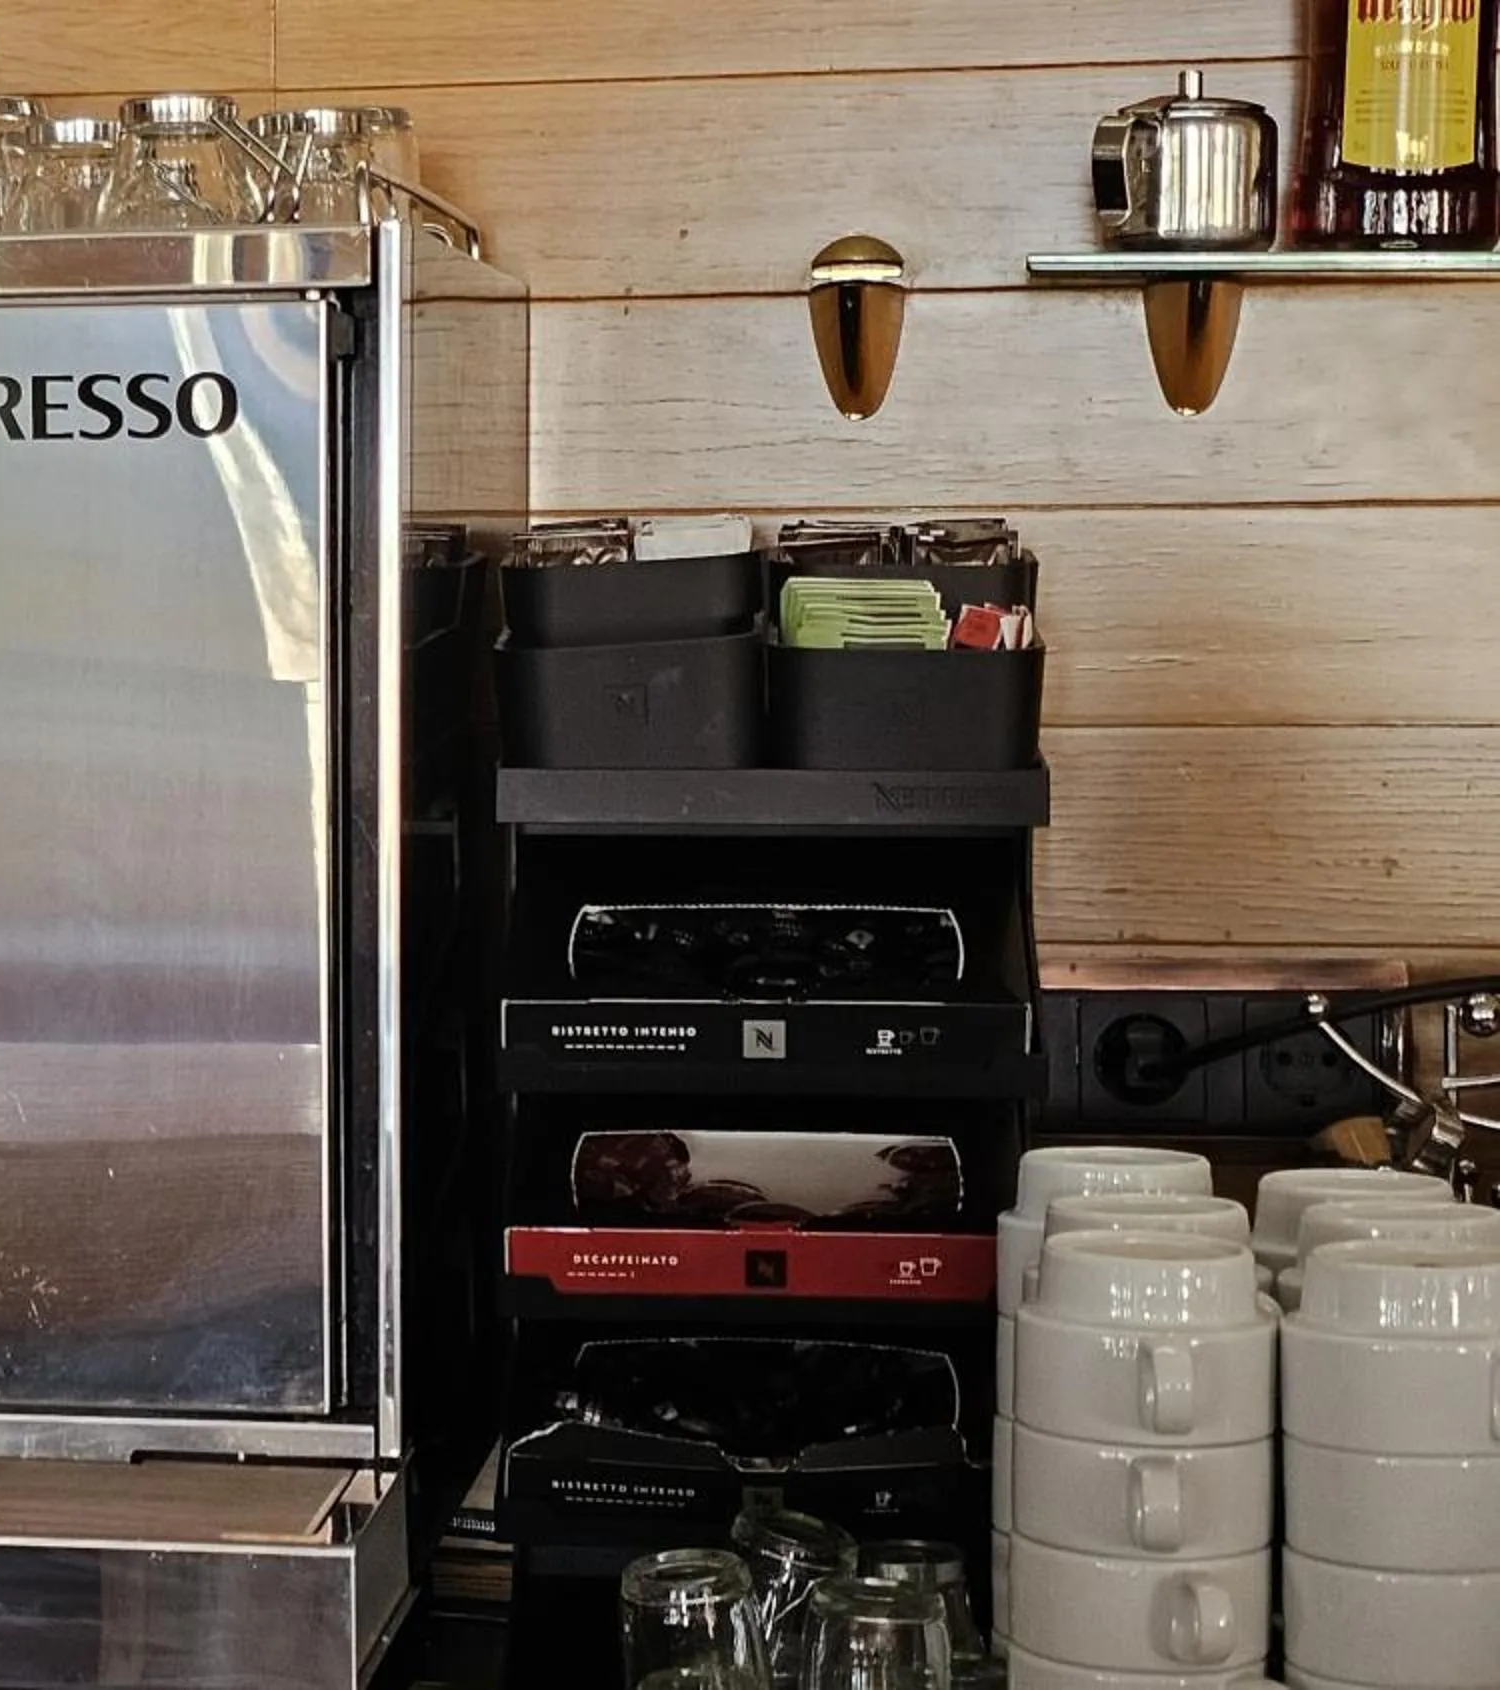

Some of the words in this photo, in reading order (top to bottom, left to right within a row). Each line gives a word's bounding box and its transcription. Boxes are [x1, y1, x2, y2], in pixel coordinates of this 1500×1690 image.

[551, 1025, 629, 1037] RISTRETTO
[635, 1026, 697, 1037] INTENSO
[573, 1254, 680, 1266] DECAFFEINATO
[551, 1479, 628, 1493] RISTRETTO
[633, 1485, 695, 1498] INTENSO
